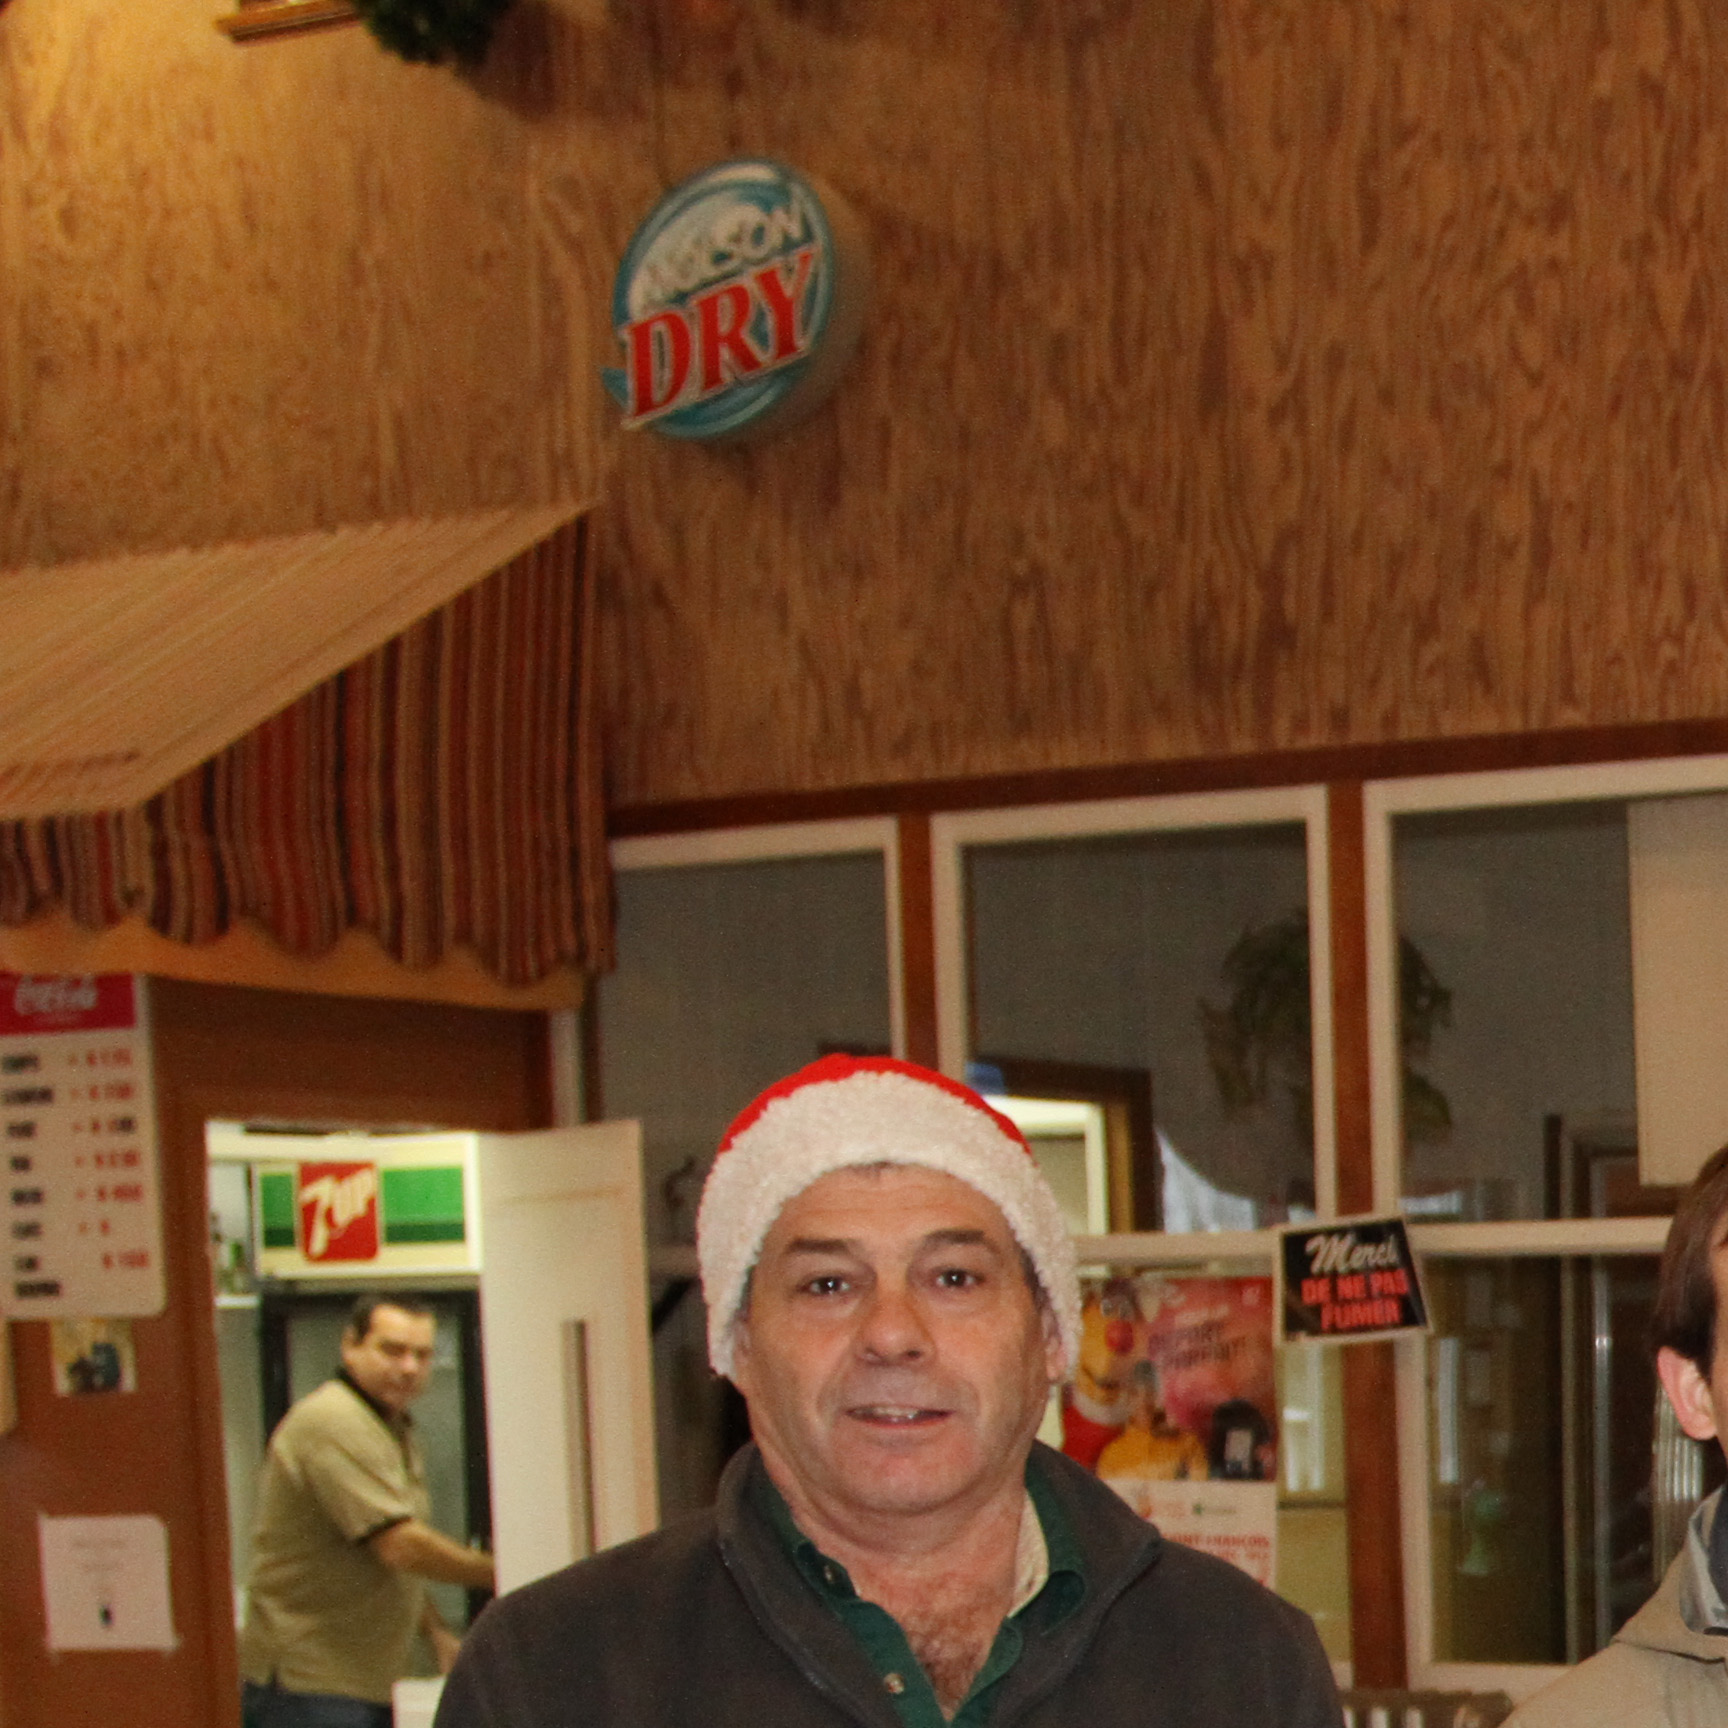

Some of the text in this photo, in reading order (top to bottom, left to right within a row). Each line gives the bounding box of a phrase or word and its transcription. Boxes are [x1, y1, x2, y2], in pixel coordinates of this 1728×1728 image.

[624, 250, 817, 420] DRY
[1304, 1233, 1400, 1275] Merci
[1301, 1268, 1410, 1306] DE NE PAS
[1320, 1298, 1400, 1330] FUMER
